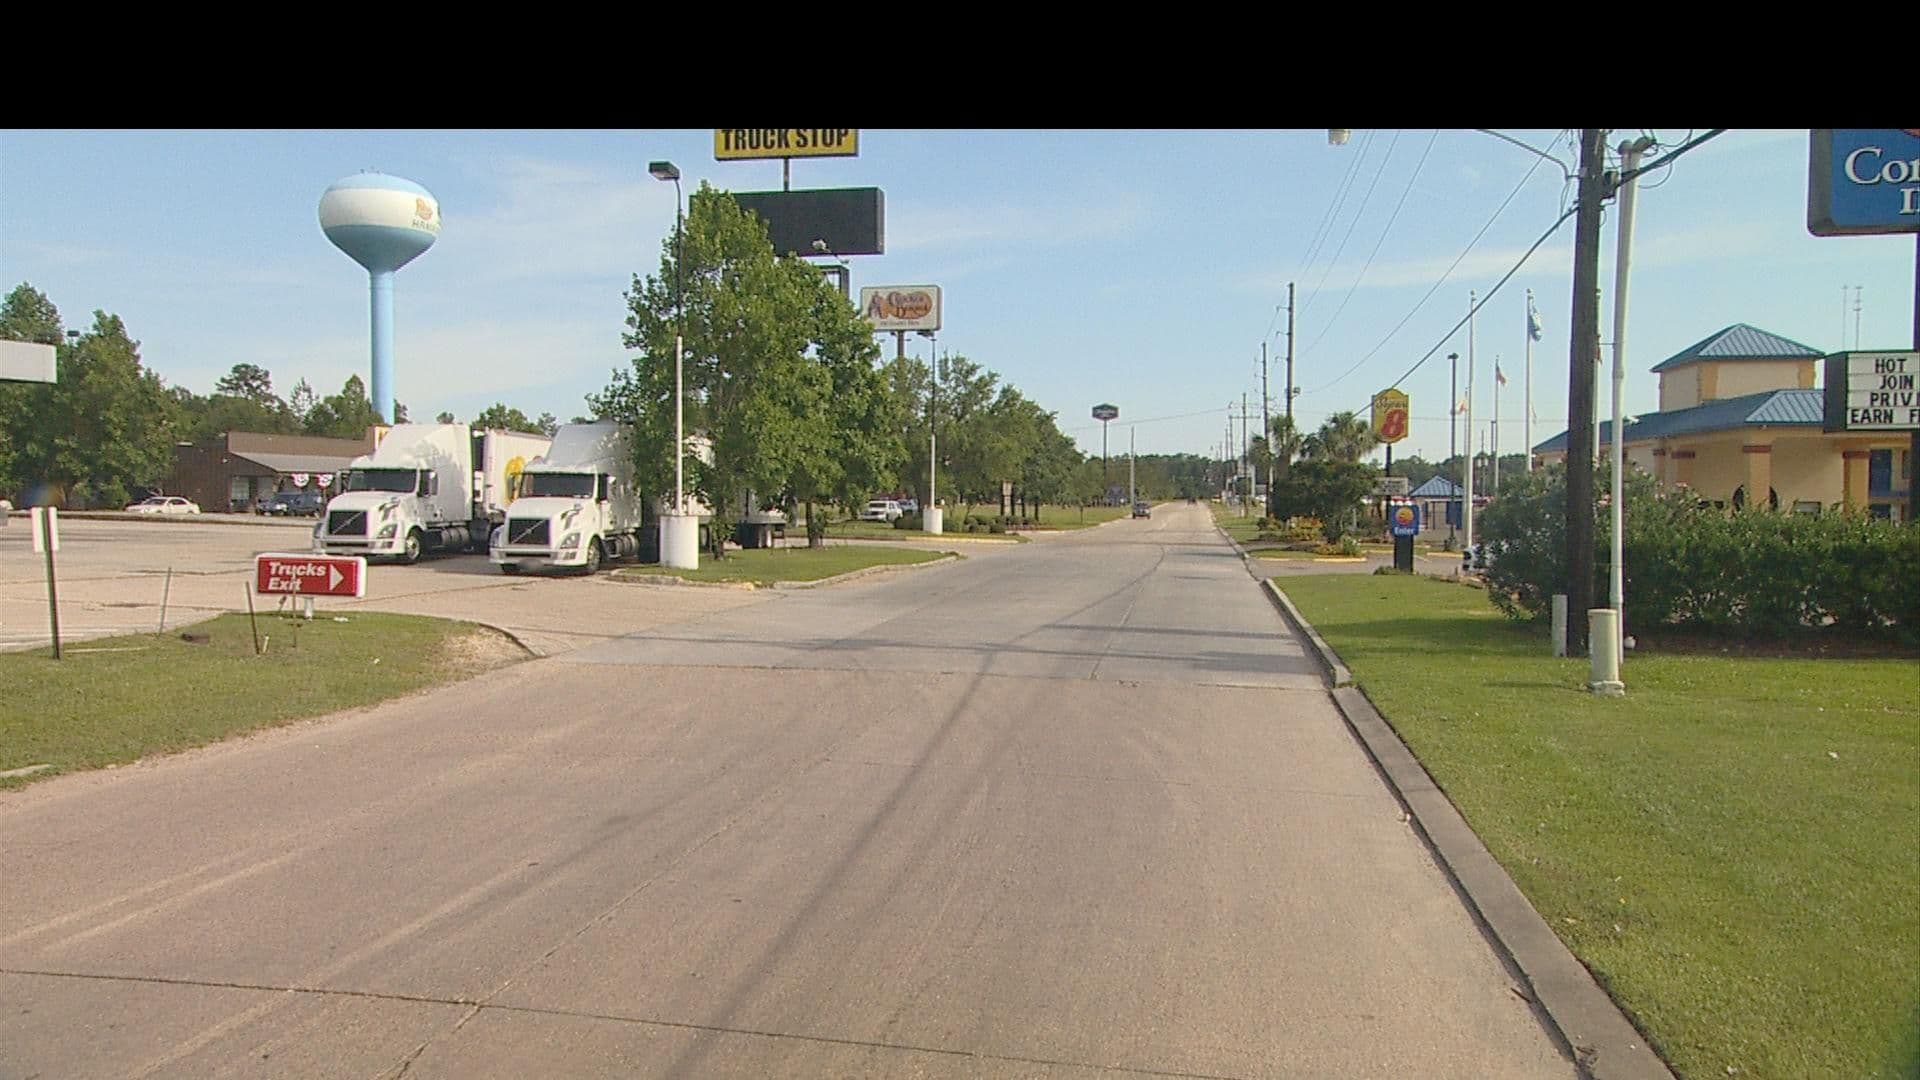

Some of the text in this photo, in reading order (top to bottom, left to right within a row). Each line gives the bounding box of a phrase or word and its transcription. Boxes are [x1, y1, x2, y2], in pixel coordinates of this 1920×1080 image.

[721, 129, 849, 150] TRUCK STOP
[1875, 358, 1907, 373] HOT
[1880, 375, 1914, 390] JOIN
[1851, 408, 1893, 424] EARN
[269, 561, 326, 577] Trucks
[268, 577, 302, 591] Exit
